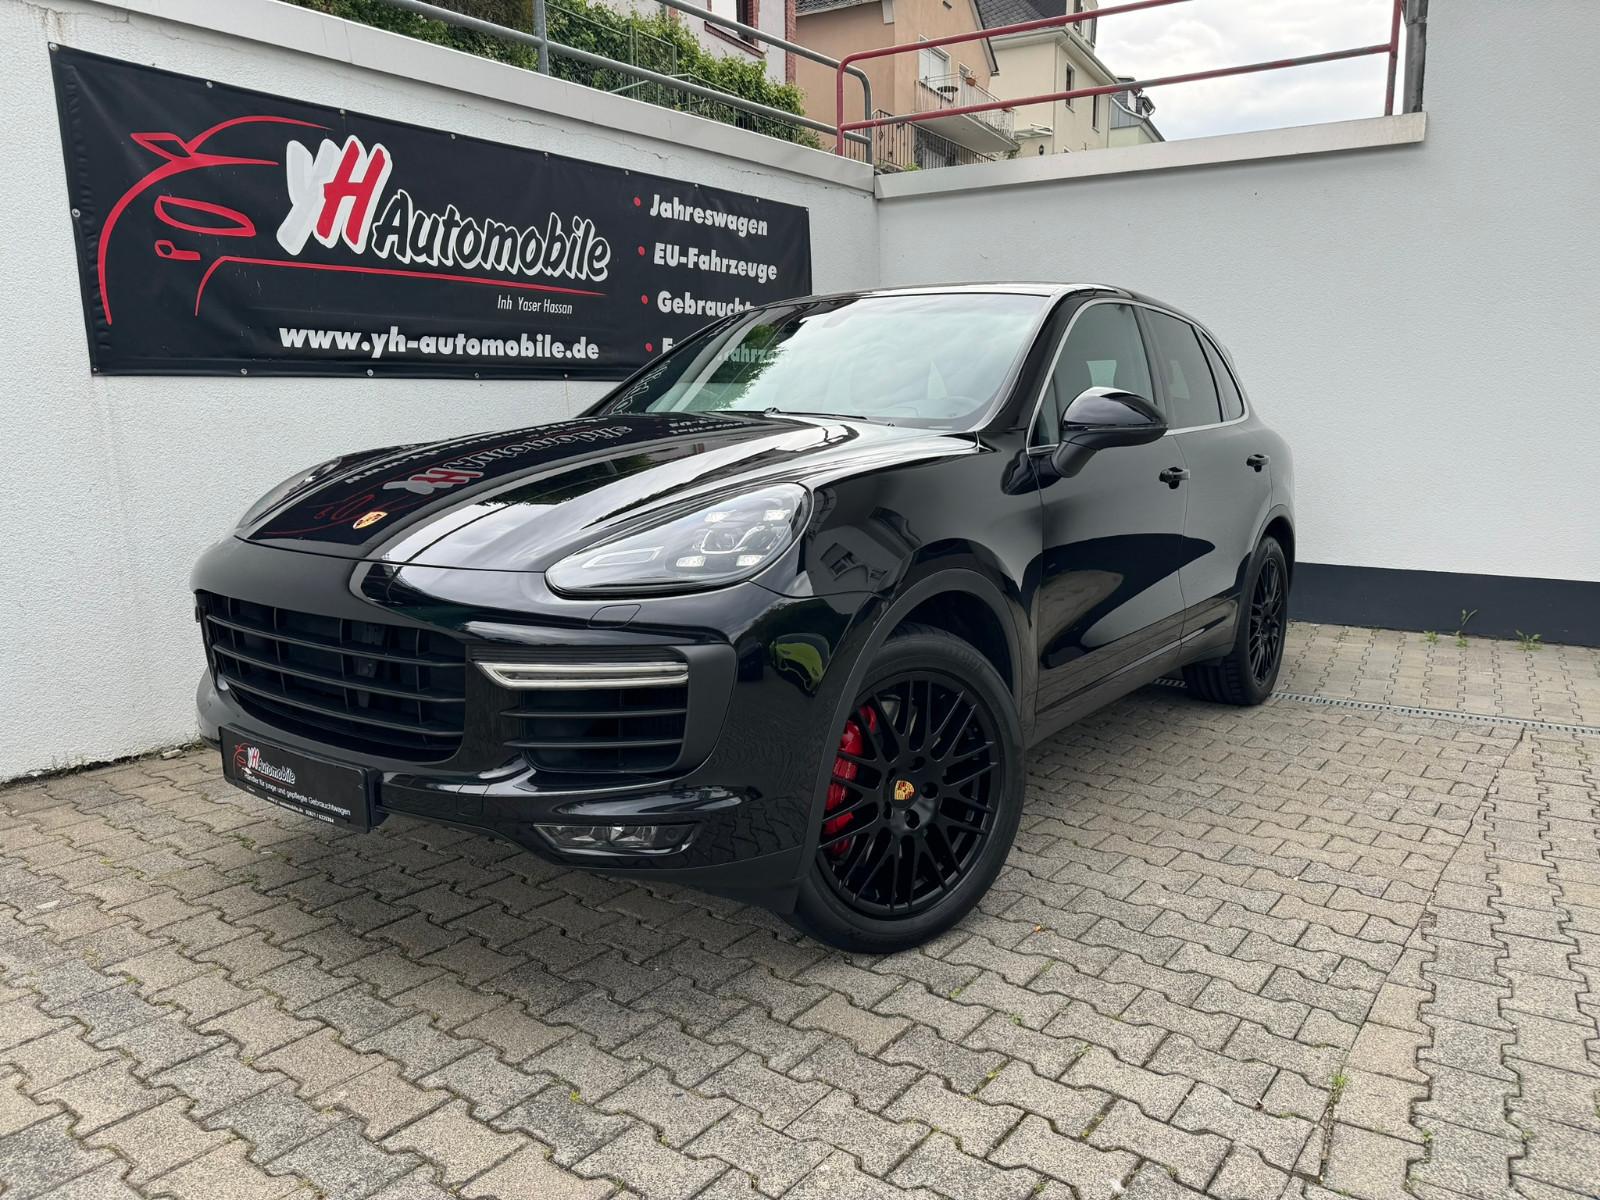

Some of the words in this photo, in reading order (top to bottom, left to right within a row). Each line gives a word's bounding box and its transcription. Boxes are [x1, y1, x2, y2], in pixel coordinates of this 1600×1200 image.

[276, 135, 393, 256] YH
[372, 188, 611, 282] Automobile
[650, 194, 768, 237] Jahreswagen
[653, 242, 777, 283] EU-Fahrzeuge
[518, 296, 541, 312] Yaser
[543, 297, 573, 314] Hassan
[657, 290, 758, 317] Gebraucht
[278, 325, 599, 359] www.yh-automobile.de
